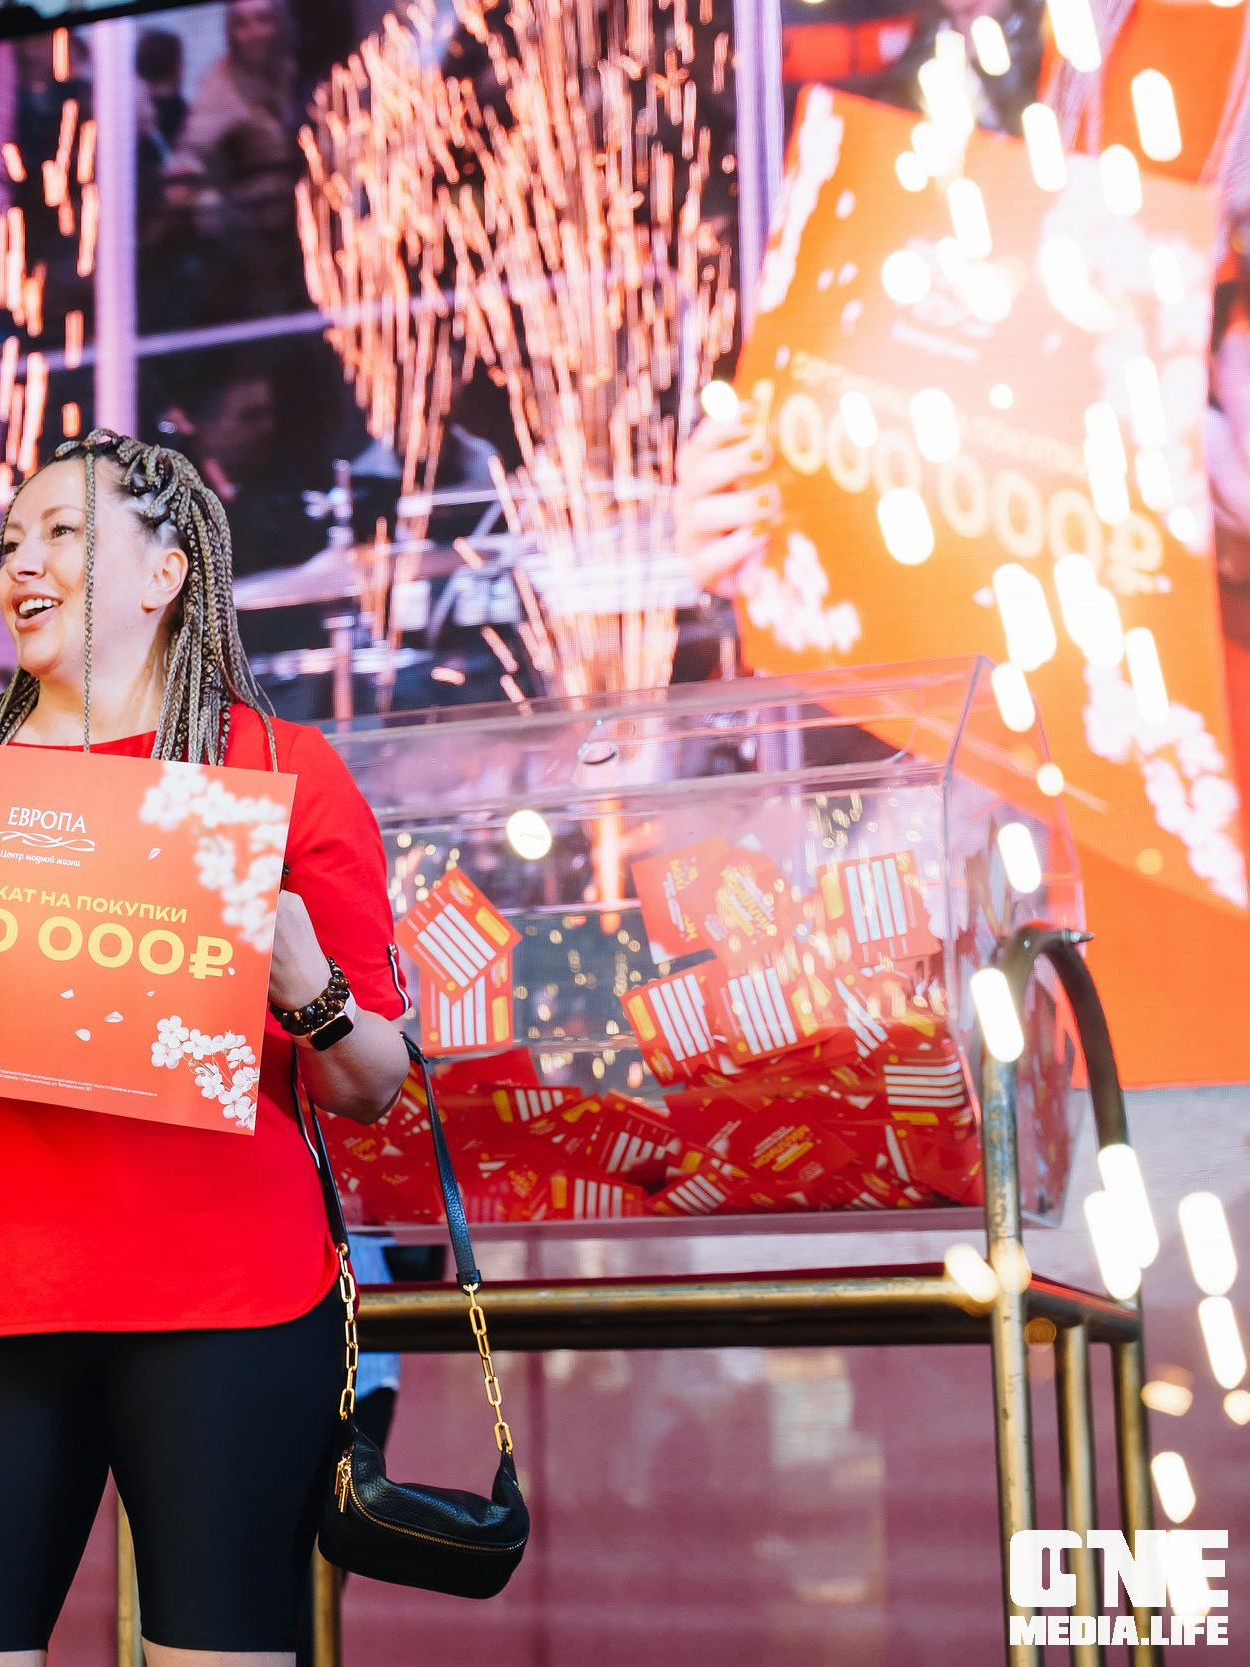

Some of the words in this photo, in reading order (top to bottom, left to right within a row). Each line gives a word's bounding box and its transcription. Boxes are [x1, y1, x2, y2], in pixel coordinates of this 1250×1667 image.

[7, 805, 87, 834] ЕВРОПА
[0, 849, 24, 862] Центр
[24, 854, 55, 865] модной
[56, 857, 81, 867] жизни
[40, 890, 73, 909] НА
[76, 894, 187, 924] ПОКУПКИ
